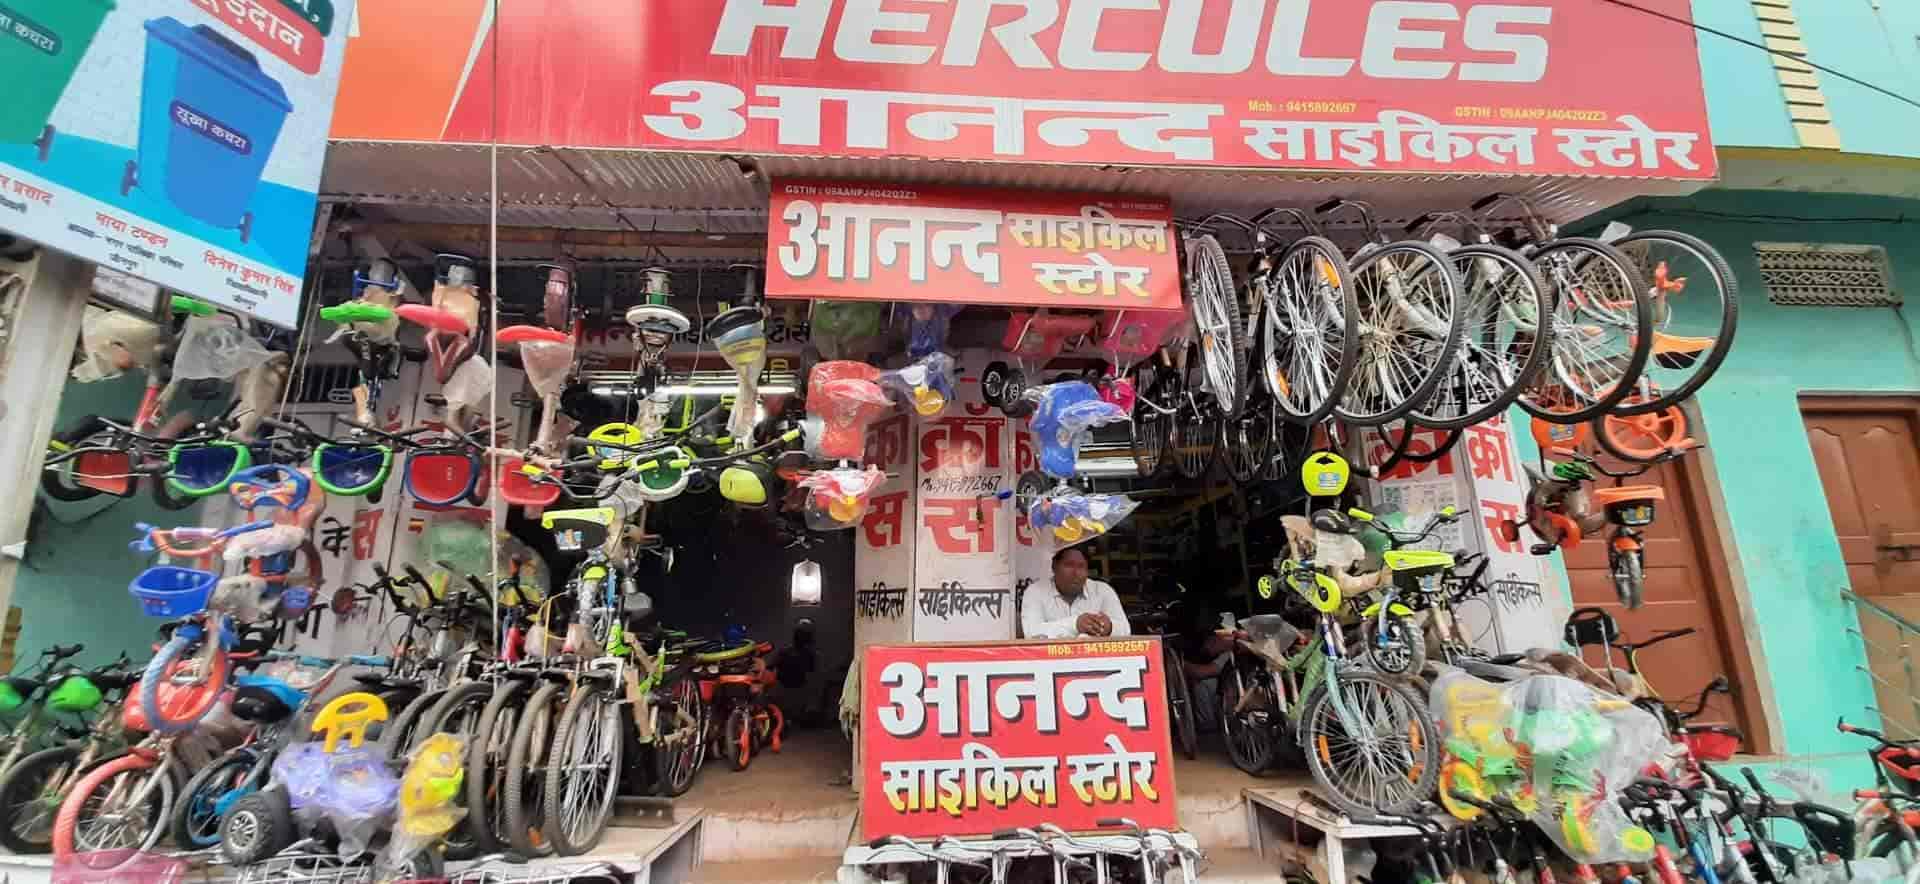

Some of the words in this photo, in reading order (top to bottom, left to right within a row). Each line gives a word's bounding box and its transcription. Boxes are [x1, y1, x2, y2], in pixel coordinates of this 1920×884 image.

[711, 0, 1552, 82] HERCULES
[175, 105, 208, 131] सूखा
[211, 124, 247, 149] कचरा
[642, 80, 1225, 160] आनन्द
[1240, 109, 1537, 168] साइकिल
[1557, 113, 1699, 170] स्टोर
[785, 184, 817, 195] GSTIN
[778, 199, 1003, 283] आनन्द
[1007, 205, 1168, 254] साइकिल
[1032, 252, 1151, 296] स्टोर
[1085, 640, 1151, 656] 9415892667
[878, 655, 1147, 736] आनन्द
[881, 742, 1059, 815] साइकिल
[1066, 733, 1159, 803] स्टोर
